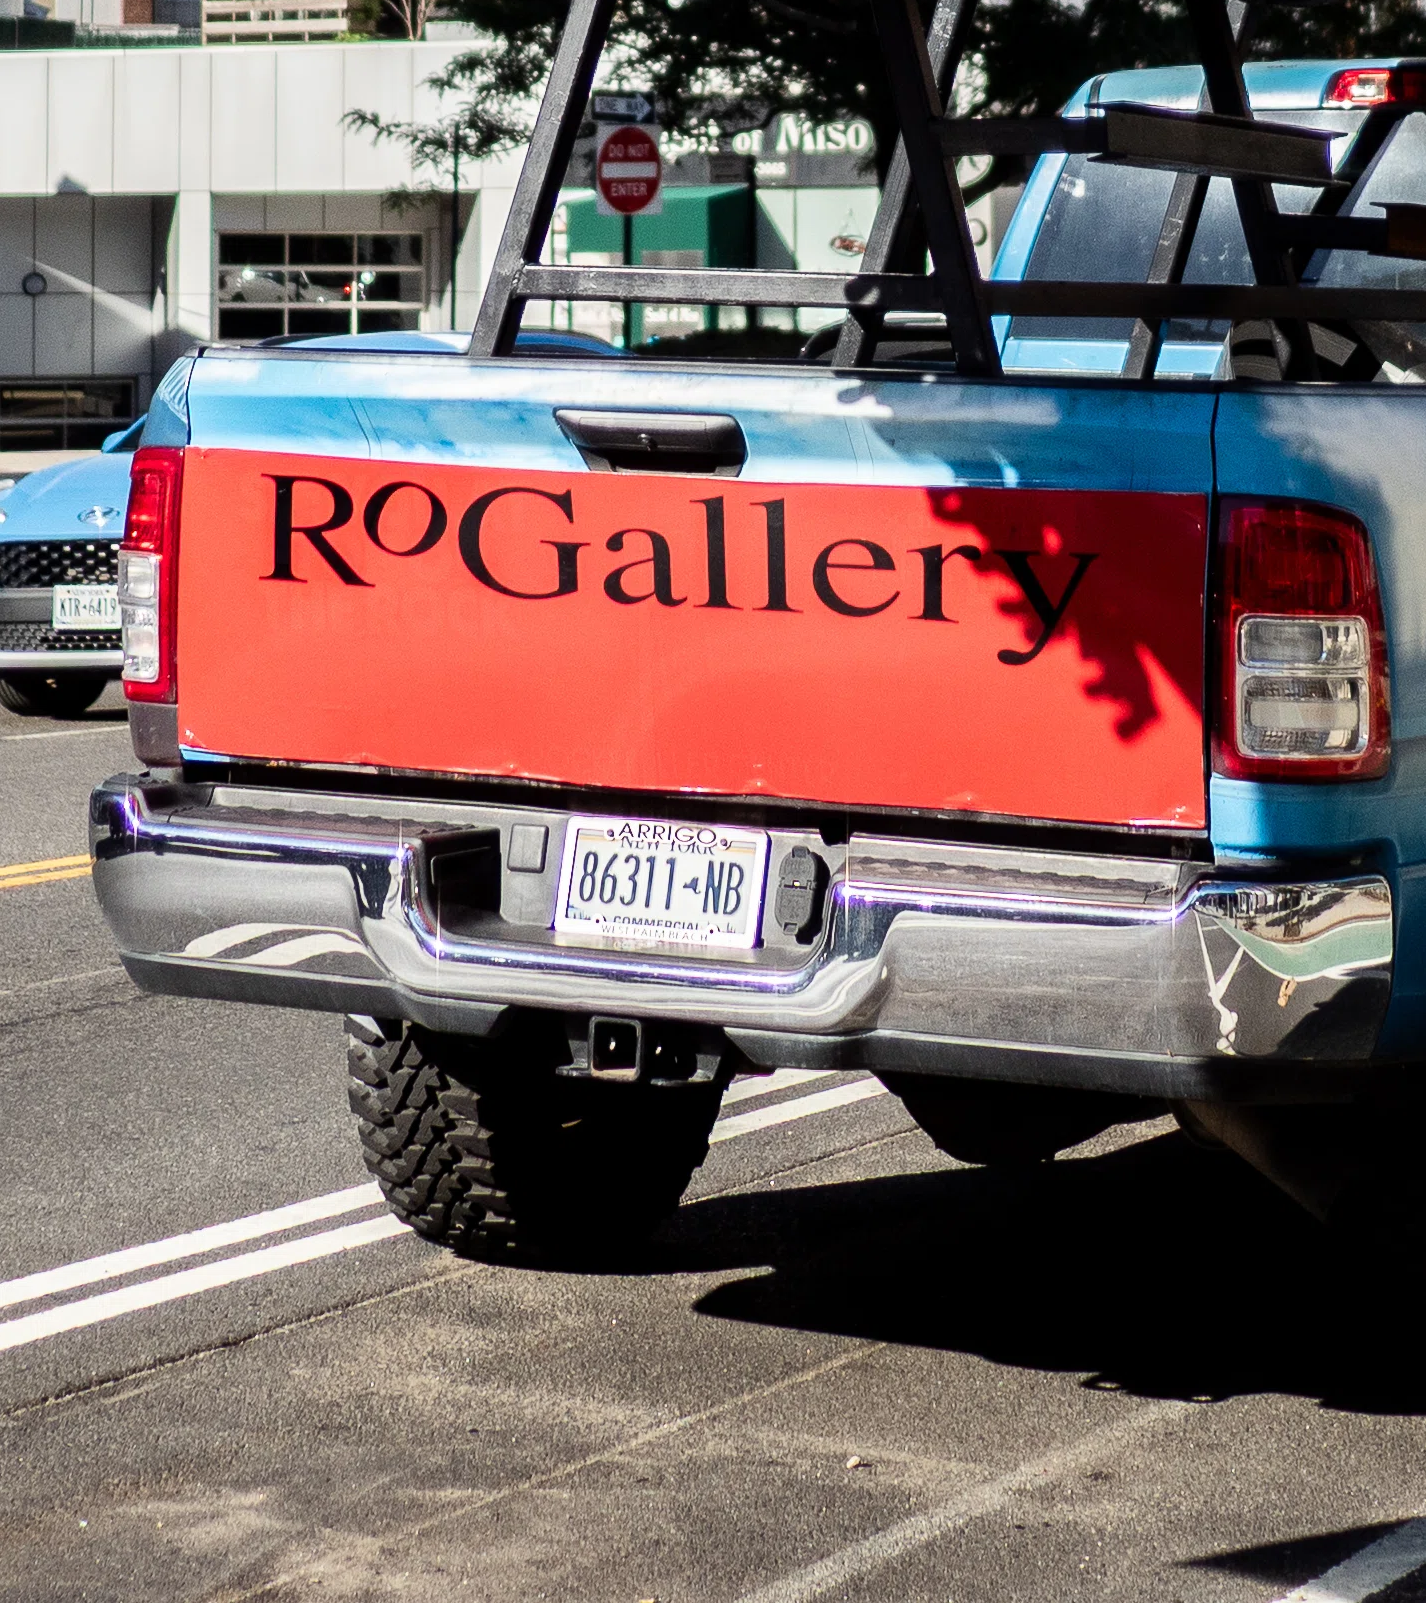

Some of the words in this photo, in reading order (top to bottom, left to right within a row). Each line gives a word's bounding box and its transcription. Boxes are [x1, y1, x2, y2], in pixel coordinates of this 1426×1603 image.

[608, 143, 624, 159] DO
[628, 143, 650, 159] NOT
[610, 182, 648, 198] ENTER
[259, 472, 1099, 667] RoGallery
[59, 597, 81, 617] KTR
[618, 822, 717, 845] ARRIGO
[578, 850, 676, 911] 86311
[702, 859, 745, 916] NB
[633, 927, 665, 939] PALM
